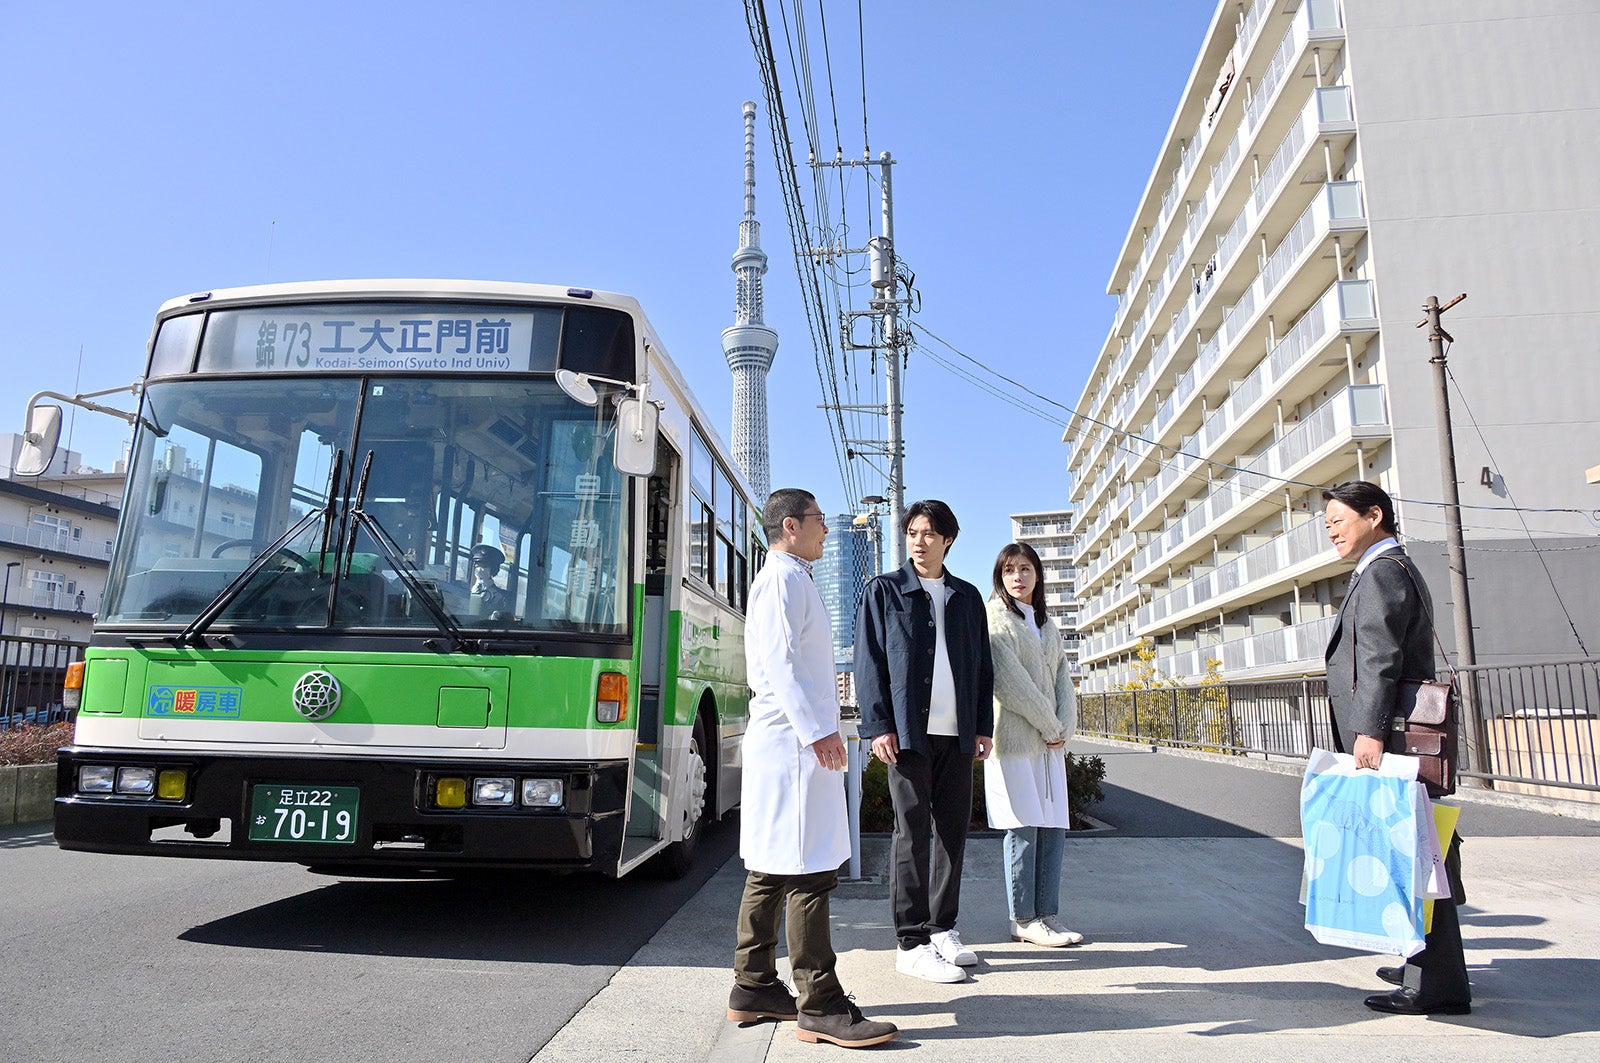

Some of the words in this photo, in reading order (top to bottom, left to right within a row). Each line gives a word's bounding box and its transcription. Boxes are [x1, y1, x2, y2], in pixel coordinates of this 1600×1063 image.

[318, 318, 512, 354] 工大正門前
[315, 357, 447, 369] Kodai-Seimon(Syuto
[451, 357, 472, 368] Ind
[476, 357, 510, 369] Univ)
[1480, 466, 1492, 489] 4
[150, 687, 238, 713] 冷暖房車
[279, 789, 332, 806] 足立22
[255, 815, 267, 825] お
[273, 808, 351, 840] 70-19
